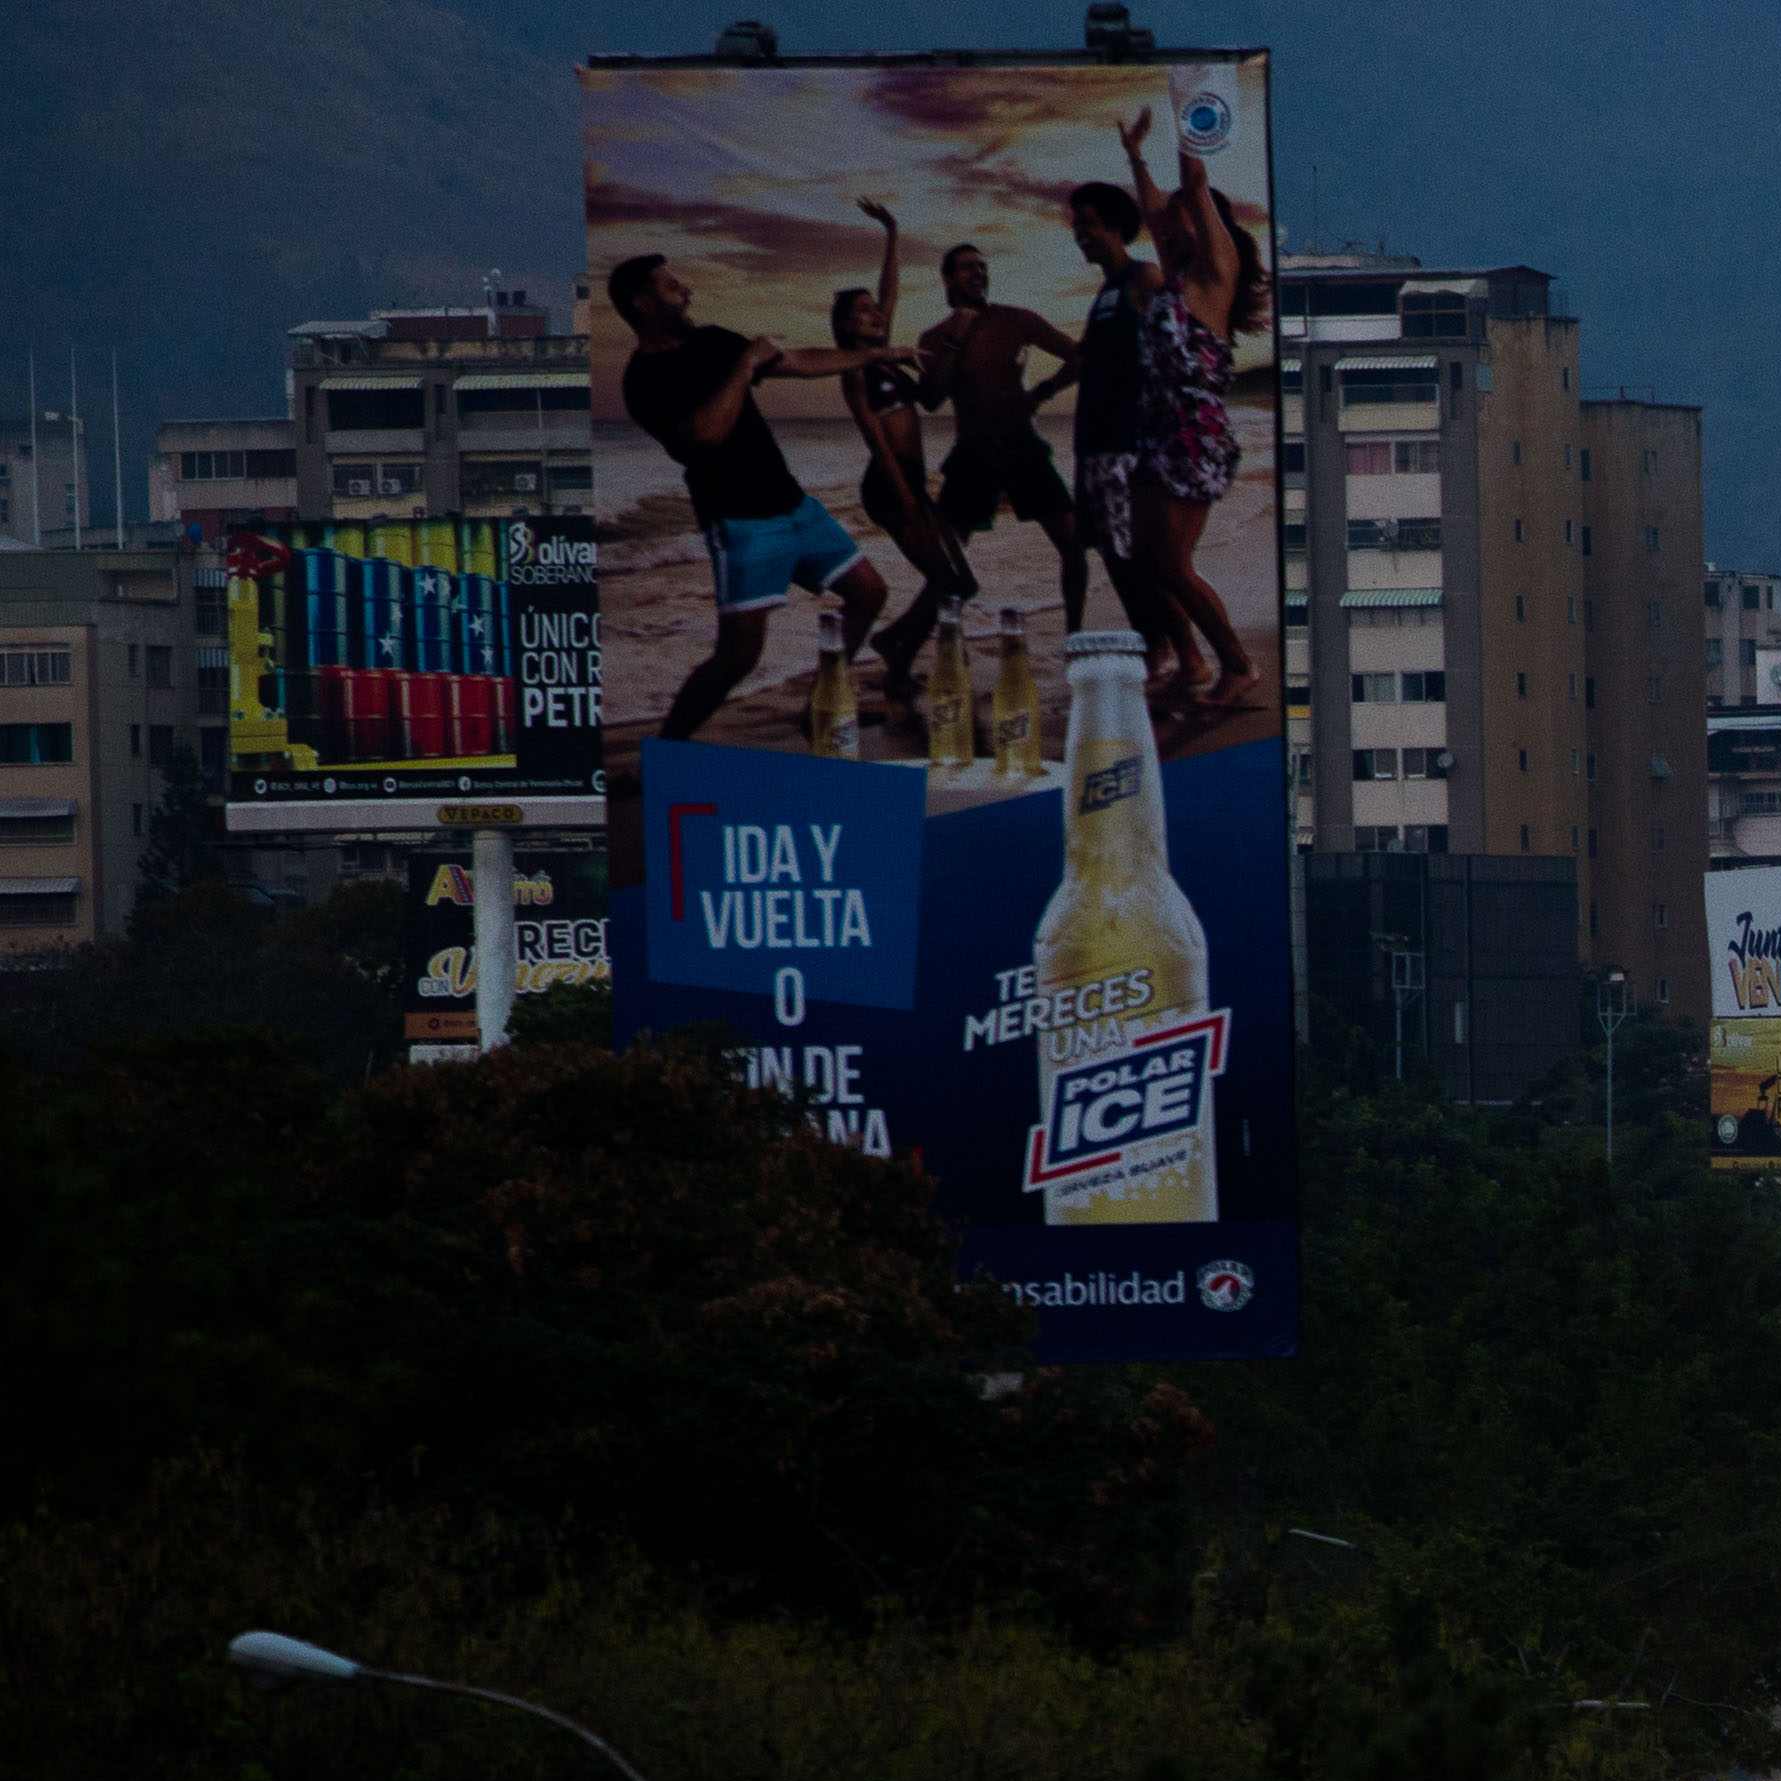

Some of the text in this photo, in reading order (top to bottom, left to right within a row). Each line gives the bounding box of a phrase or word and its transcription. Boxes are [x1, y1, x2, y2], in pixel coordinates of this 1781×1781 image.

[521, 650, 579, 685] CON
[723, 824, 843, 884] IDA Y
[700, 889, 872, 949] VUELTA
[774, 966, 807, 1027] O
[963, 969, 1153, 1051] MERECES
[995, 965, 1037, 1002] TE
[1049, 1017, 1127, 1063] UNA
[802, 1045, 865, 1105] DE
[1062, 1048, 1198, 1102] POLAR
[1058, 1168, 1125, 1197] ERVEZA
